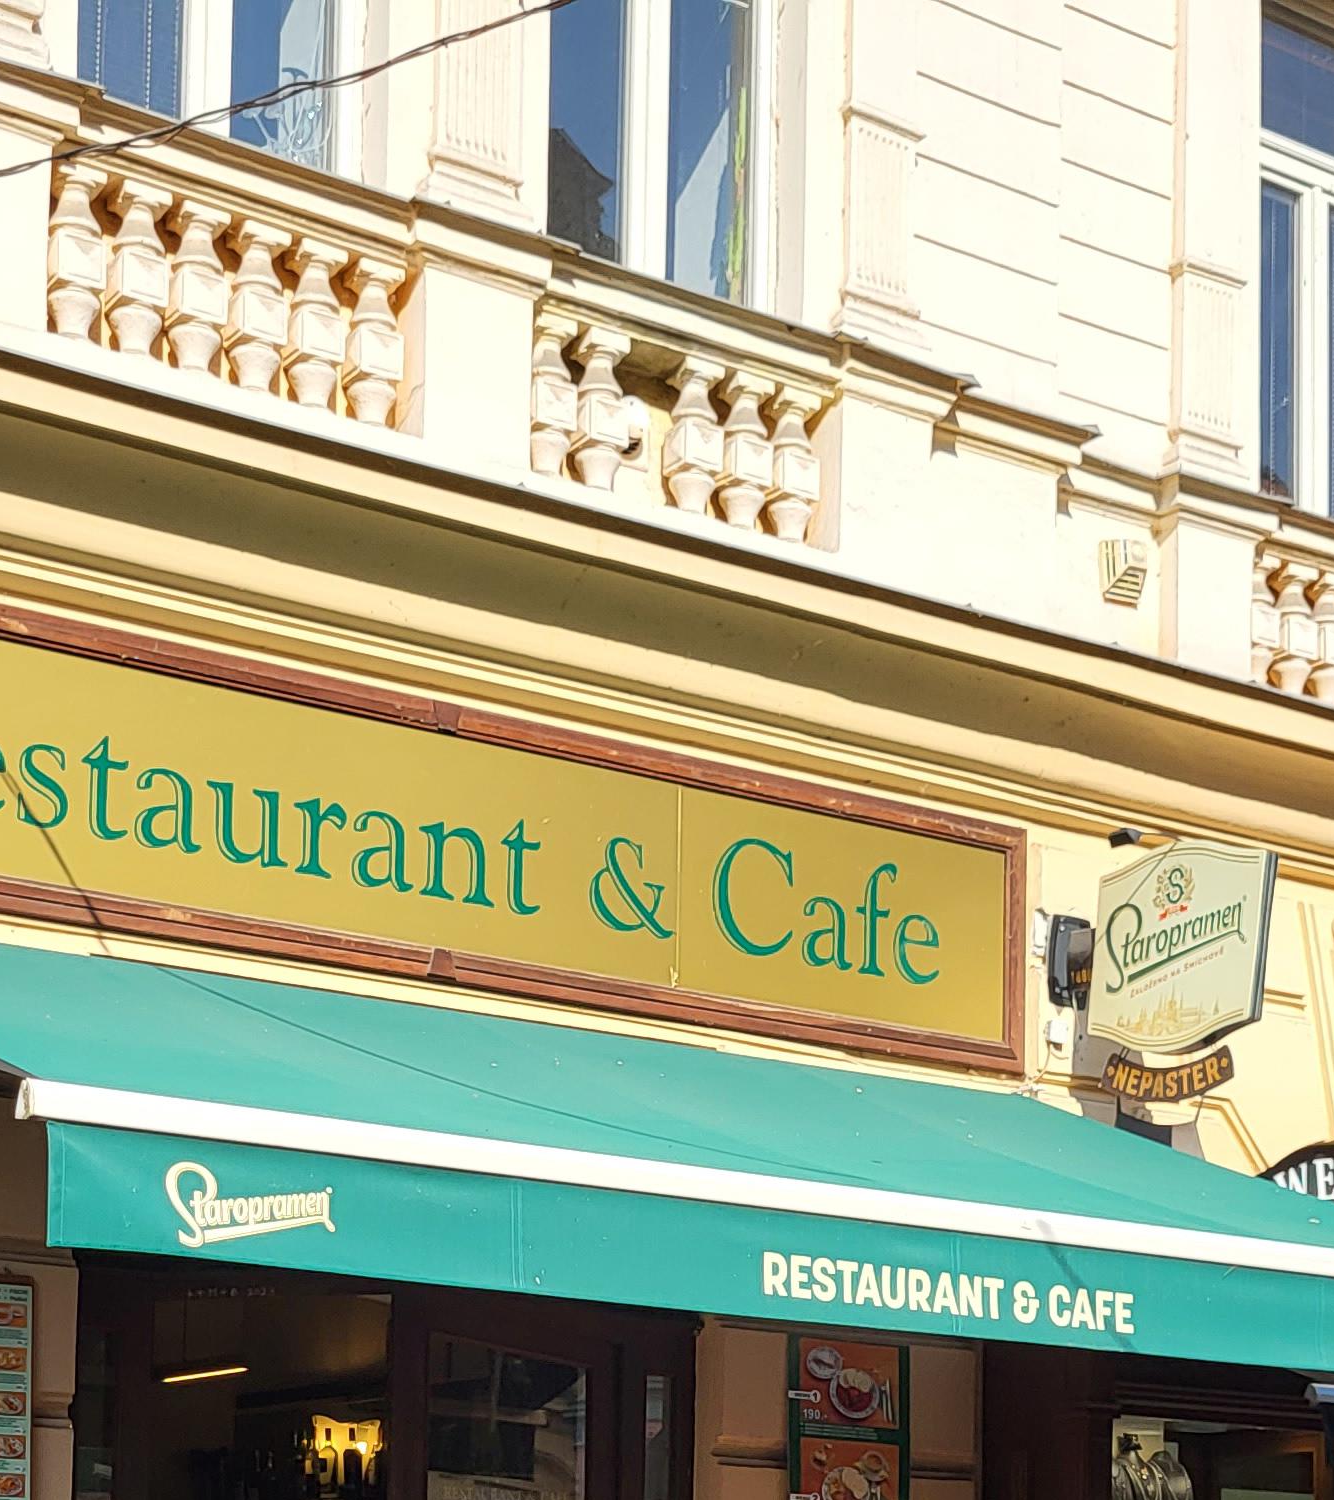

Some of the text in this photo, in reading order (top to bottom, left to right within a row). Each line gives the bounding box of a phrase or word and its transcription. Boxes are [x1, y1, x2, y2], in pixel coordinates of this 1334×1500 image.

[590, 837, 674, 939] &
[712, 838, 939, 984] Cafe
[1105, 902, 1247, 993] Staropramen
[1114, 1056, 1220, 1099] NEPASTER
[165, 1161, 335, 1248] Staropramen
[763, 1251, 1135, 1334] RESTAURANT & CAFE
